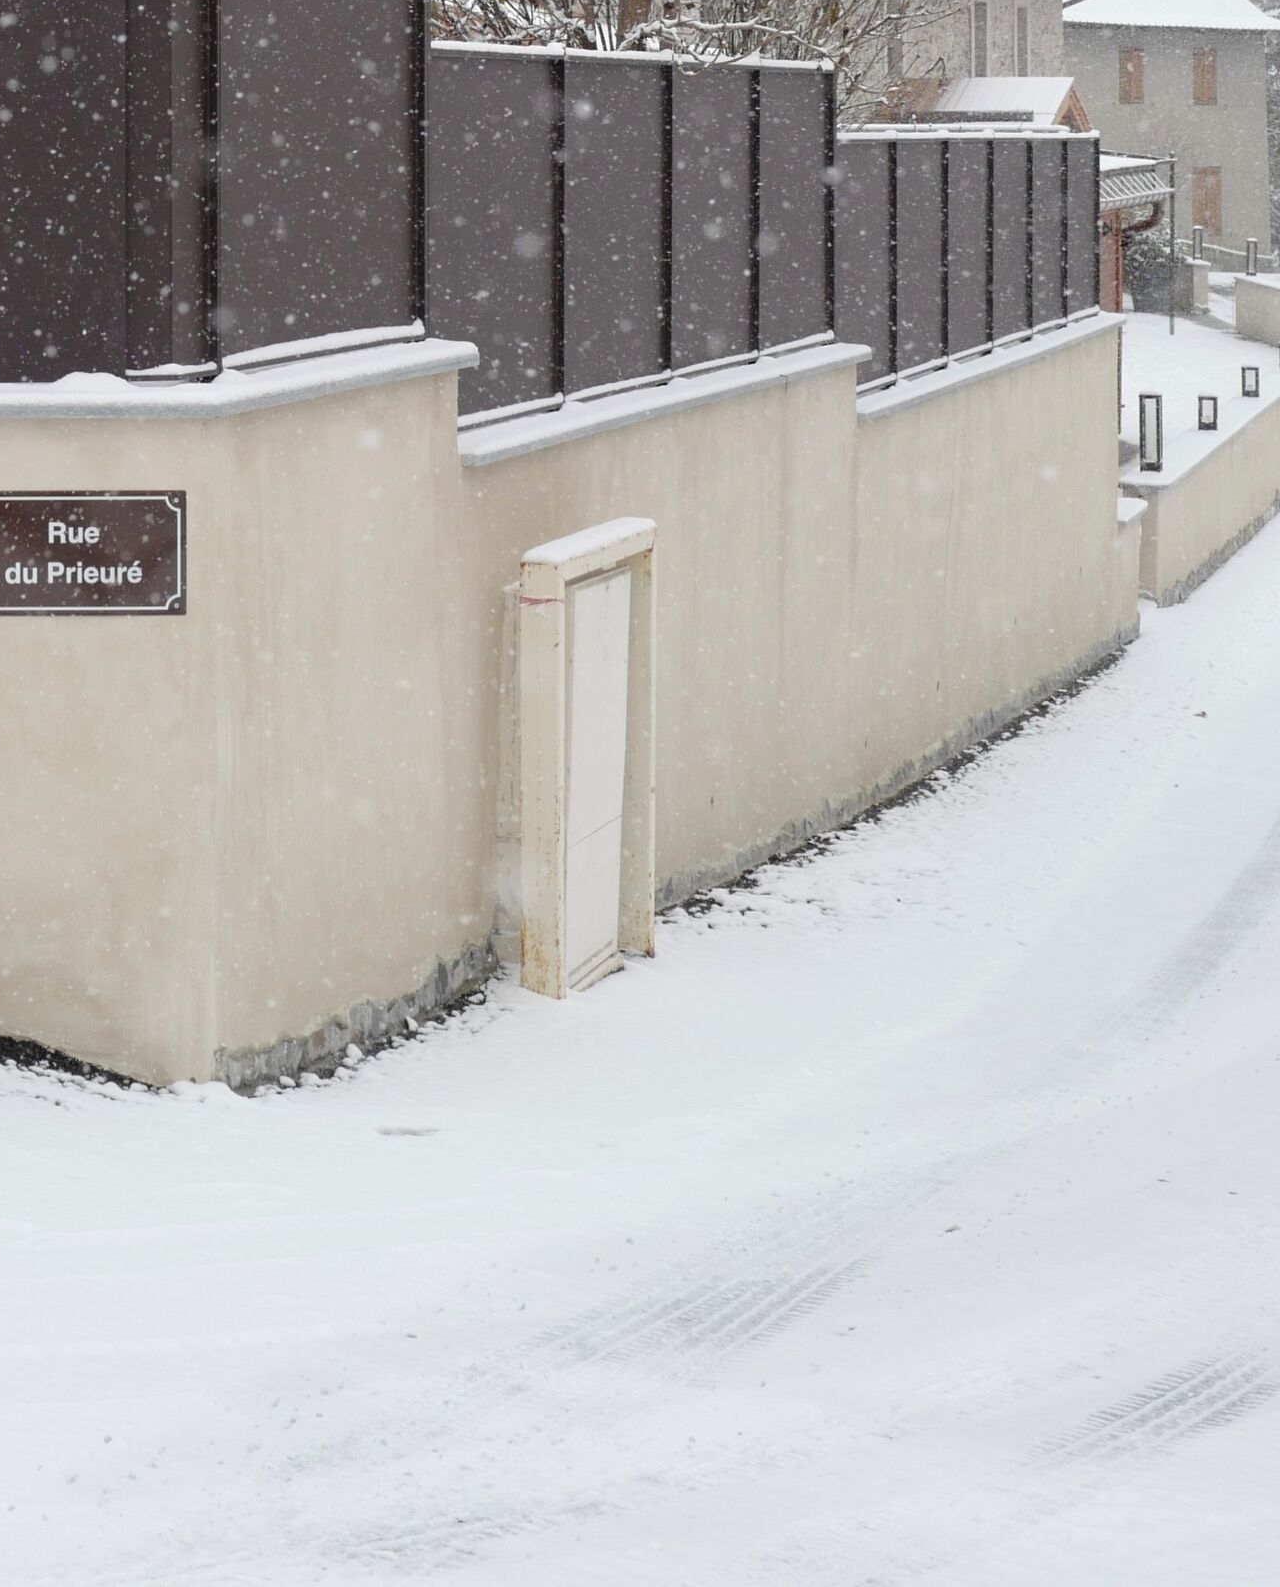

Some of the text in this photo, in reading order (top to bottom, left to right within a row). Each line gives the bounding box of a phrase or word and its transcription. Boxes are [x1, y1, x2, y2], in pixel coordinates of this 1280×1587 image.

[47, 521, 100, 544] Rue
[4, 560, 143, 584] du Prieuré
